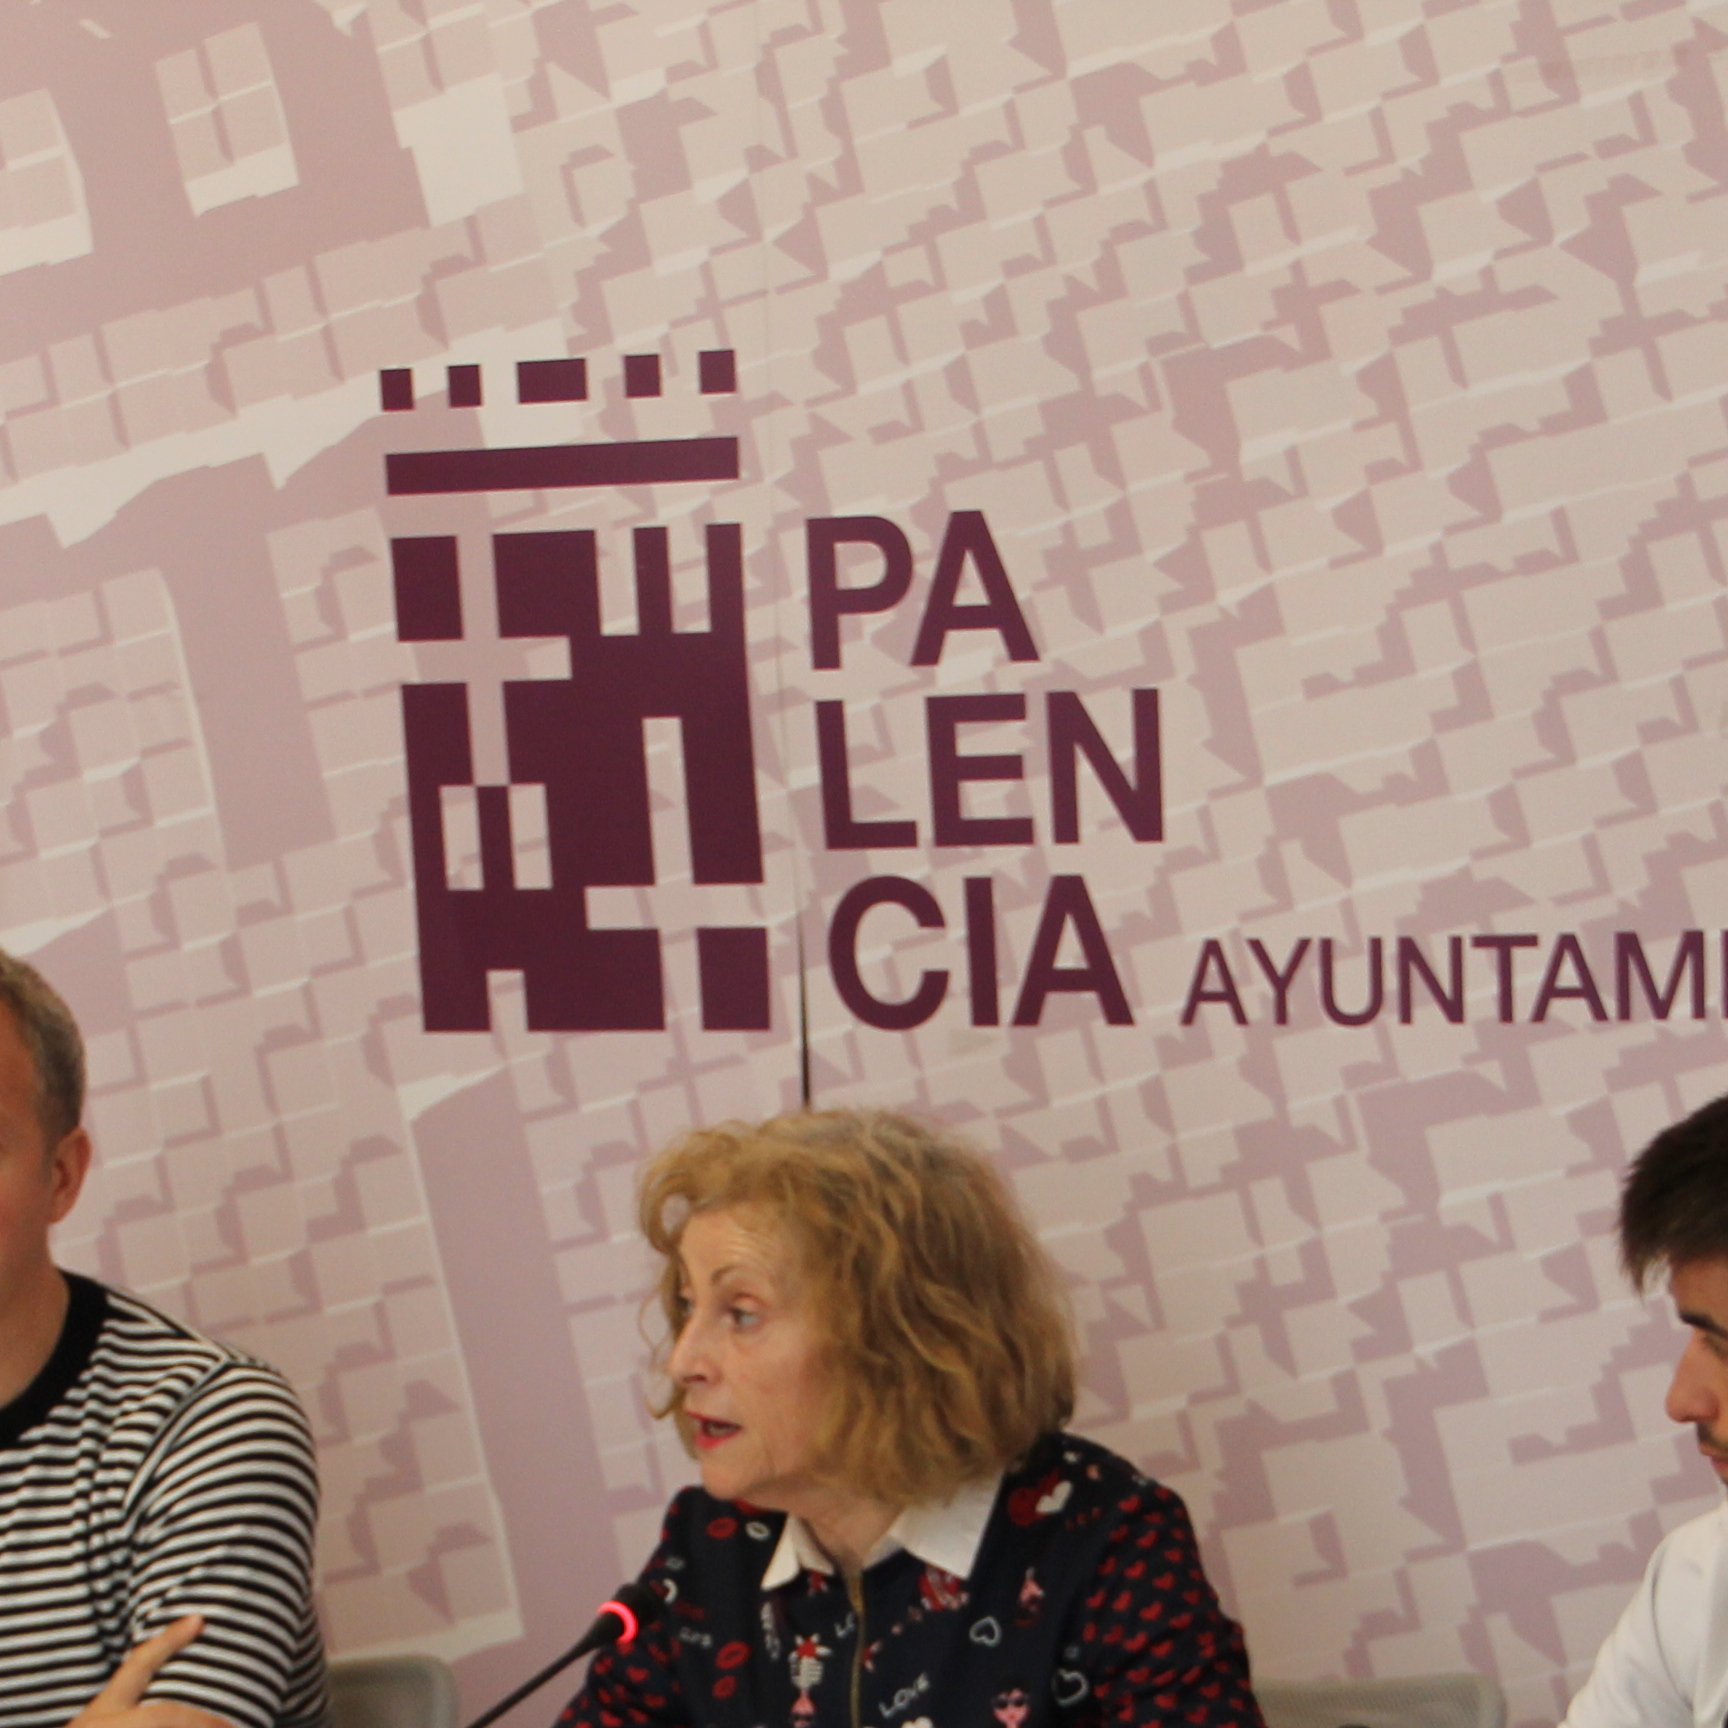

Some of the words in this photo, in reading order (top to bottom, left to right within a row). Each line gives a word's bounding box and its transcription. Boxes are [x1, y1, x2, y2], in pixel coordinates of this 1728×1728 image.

[805, 509, 1040, 672] PA
[813, 687, 1166, 852] LEN
[825, 873, 1135, 1030] CIA
